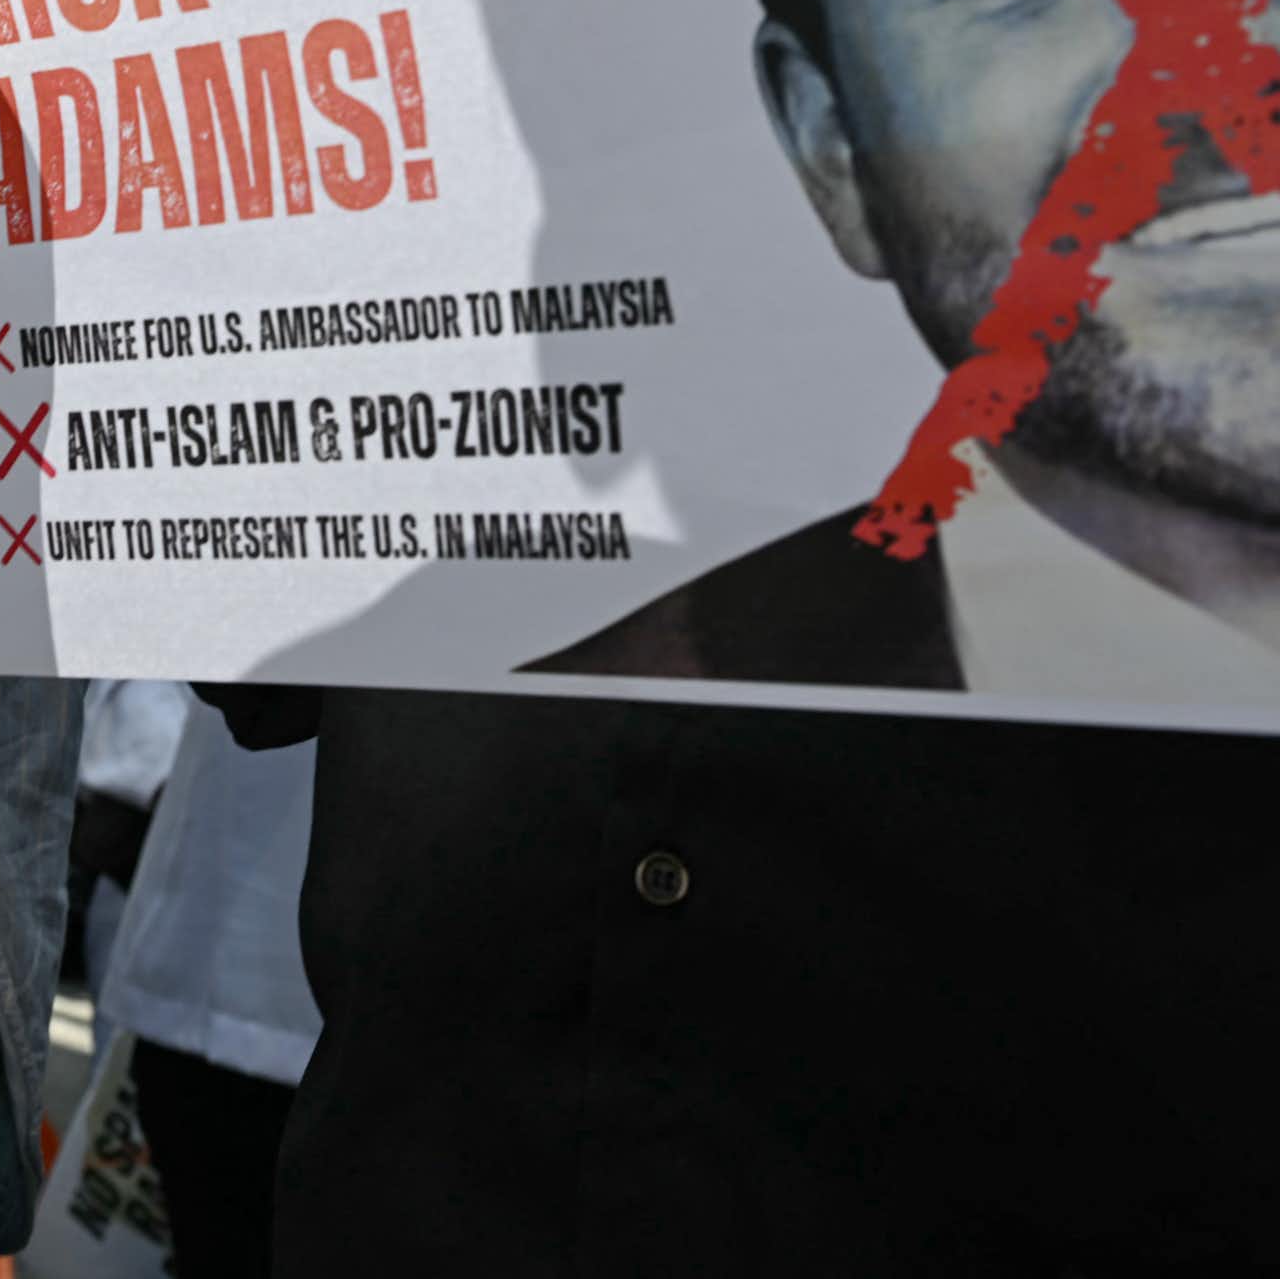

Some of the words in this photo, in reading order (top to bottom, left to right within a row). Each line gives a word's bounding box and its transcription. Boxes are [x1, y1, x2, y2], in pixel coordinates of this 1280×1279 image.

[19, 320, 139, 368] NOMINEE
[143, 315, 194, 360] FOR
[198, 311, 253, 356] U.S.
[259, 293, 462, 352] AMBASSADOR
[465, 290, 503, 337] TO
[510, 277, 675, 335] MALAYSIA
[67, 399, 301, 472] ANTI-ISLAM
[308, 397, 343, 463] &
[350, 382, 624, 460] PRO-ZIONIST
[46, 520, 117, 561] UNFIT
[121, 519, 155, 561] TO
[160, 515, 308, 560] REPRESENT
[315, 515, 367, 559] THE
[372, 513, 428, 559] U.S.
[434, 513, 467, 560] IN
[473, 512, 632, 561] MALAYSIA
